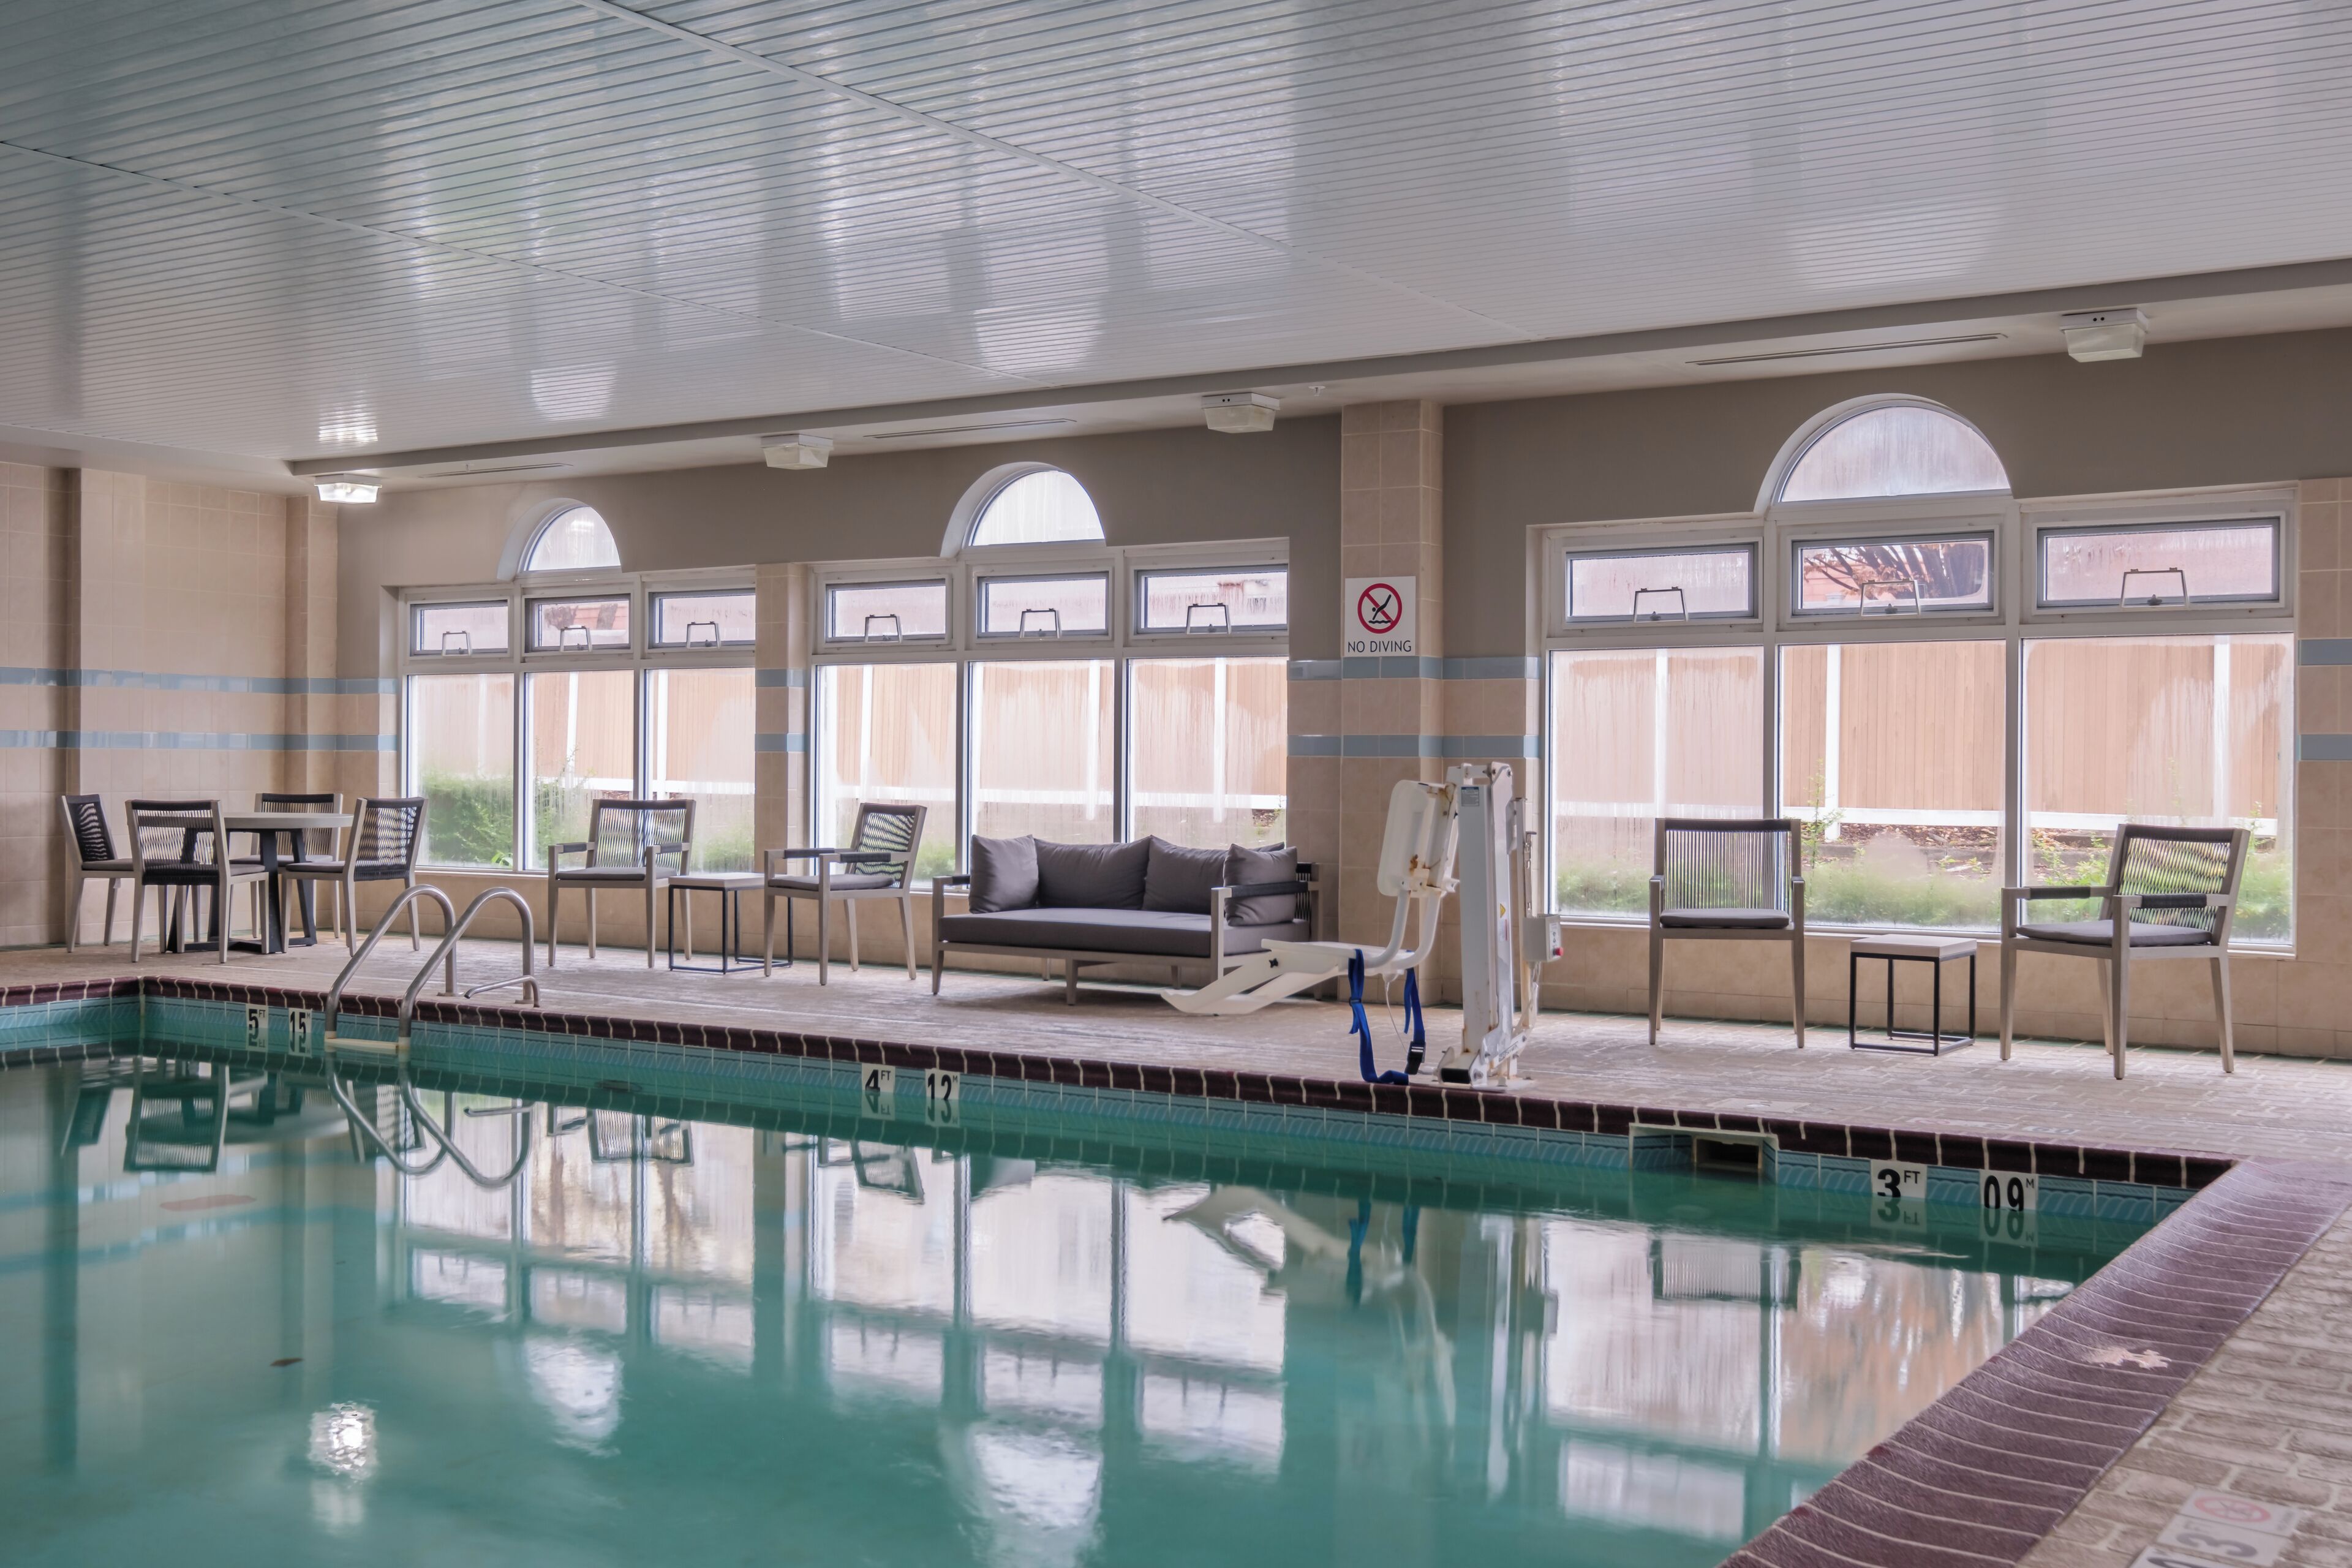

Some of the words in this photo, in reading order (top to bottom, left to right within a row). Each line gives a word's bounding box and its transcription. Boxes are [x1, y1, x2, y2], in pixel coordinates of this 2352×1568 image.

[1348, 641, 1365, 653] NO
[1370, 640, 1412, 653] DIVING
[249, 1008, 259, 1028] 5
[258, 1009, 266, 1018] FT
[290, 1011, 306, 1033] 15
[865, 1069, 881, 1092] 4
[881, 1070, 891, 1081] FT
[927, 1073, 952, 1101] 12
[952, 1076, 958, 1085] M
[1877, 1168, 1902, 1198] 3
[1903, 1170, 1920, 1185] FT
[2026, 1178, 2034, 1189] M
